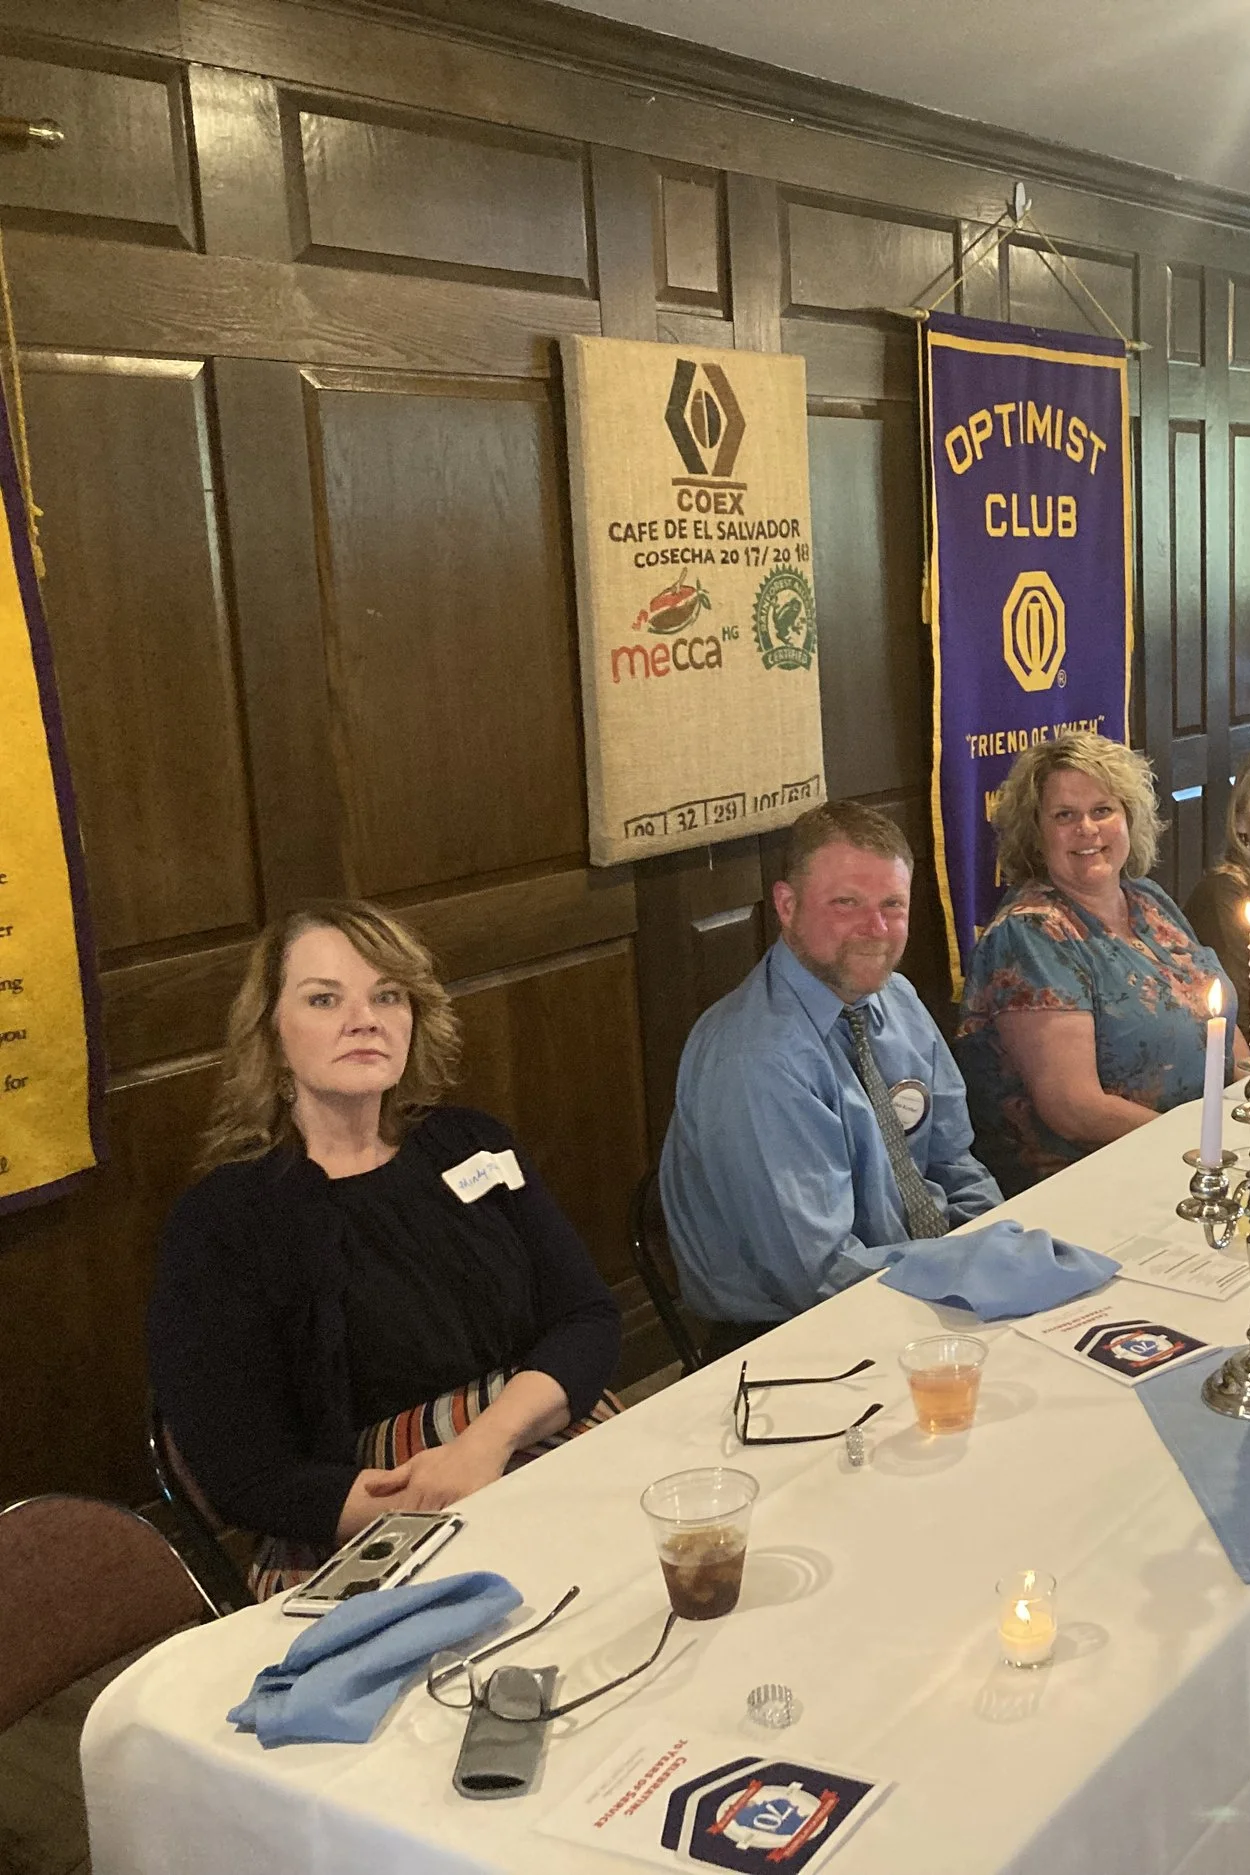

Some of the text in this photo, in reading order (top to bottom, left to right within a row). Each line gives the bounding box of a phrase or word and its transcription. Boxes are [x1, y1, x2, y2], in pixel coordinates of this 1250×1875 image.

[945, 400, 1107, 475] OPTIMIST
[677, 489, 744, 515] COEX
[985, 493, 1077, 537] CLUB
[608, 518, 801, 542] CAFE DE EL SALVADOR
[634, 548, 715, 568] COSECHA
[722, 625, 740, 642] HG
[611, 635, 722, 684] mecca
[1031, 726, 1049, 746] OF
[677, 808, 698, 832] 32
[1130, 1341, 1157, 1354] 70
[754, 1803, 793, 1830] 70
